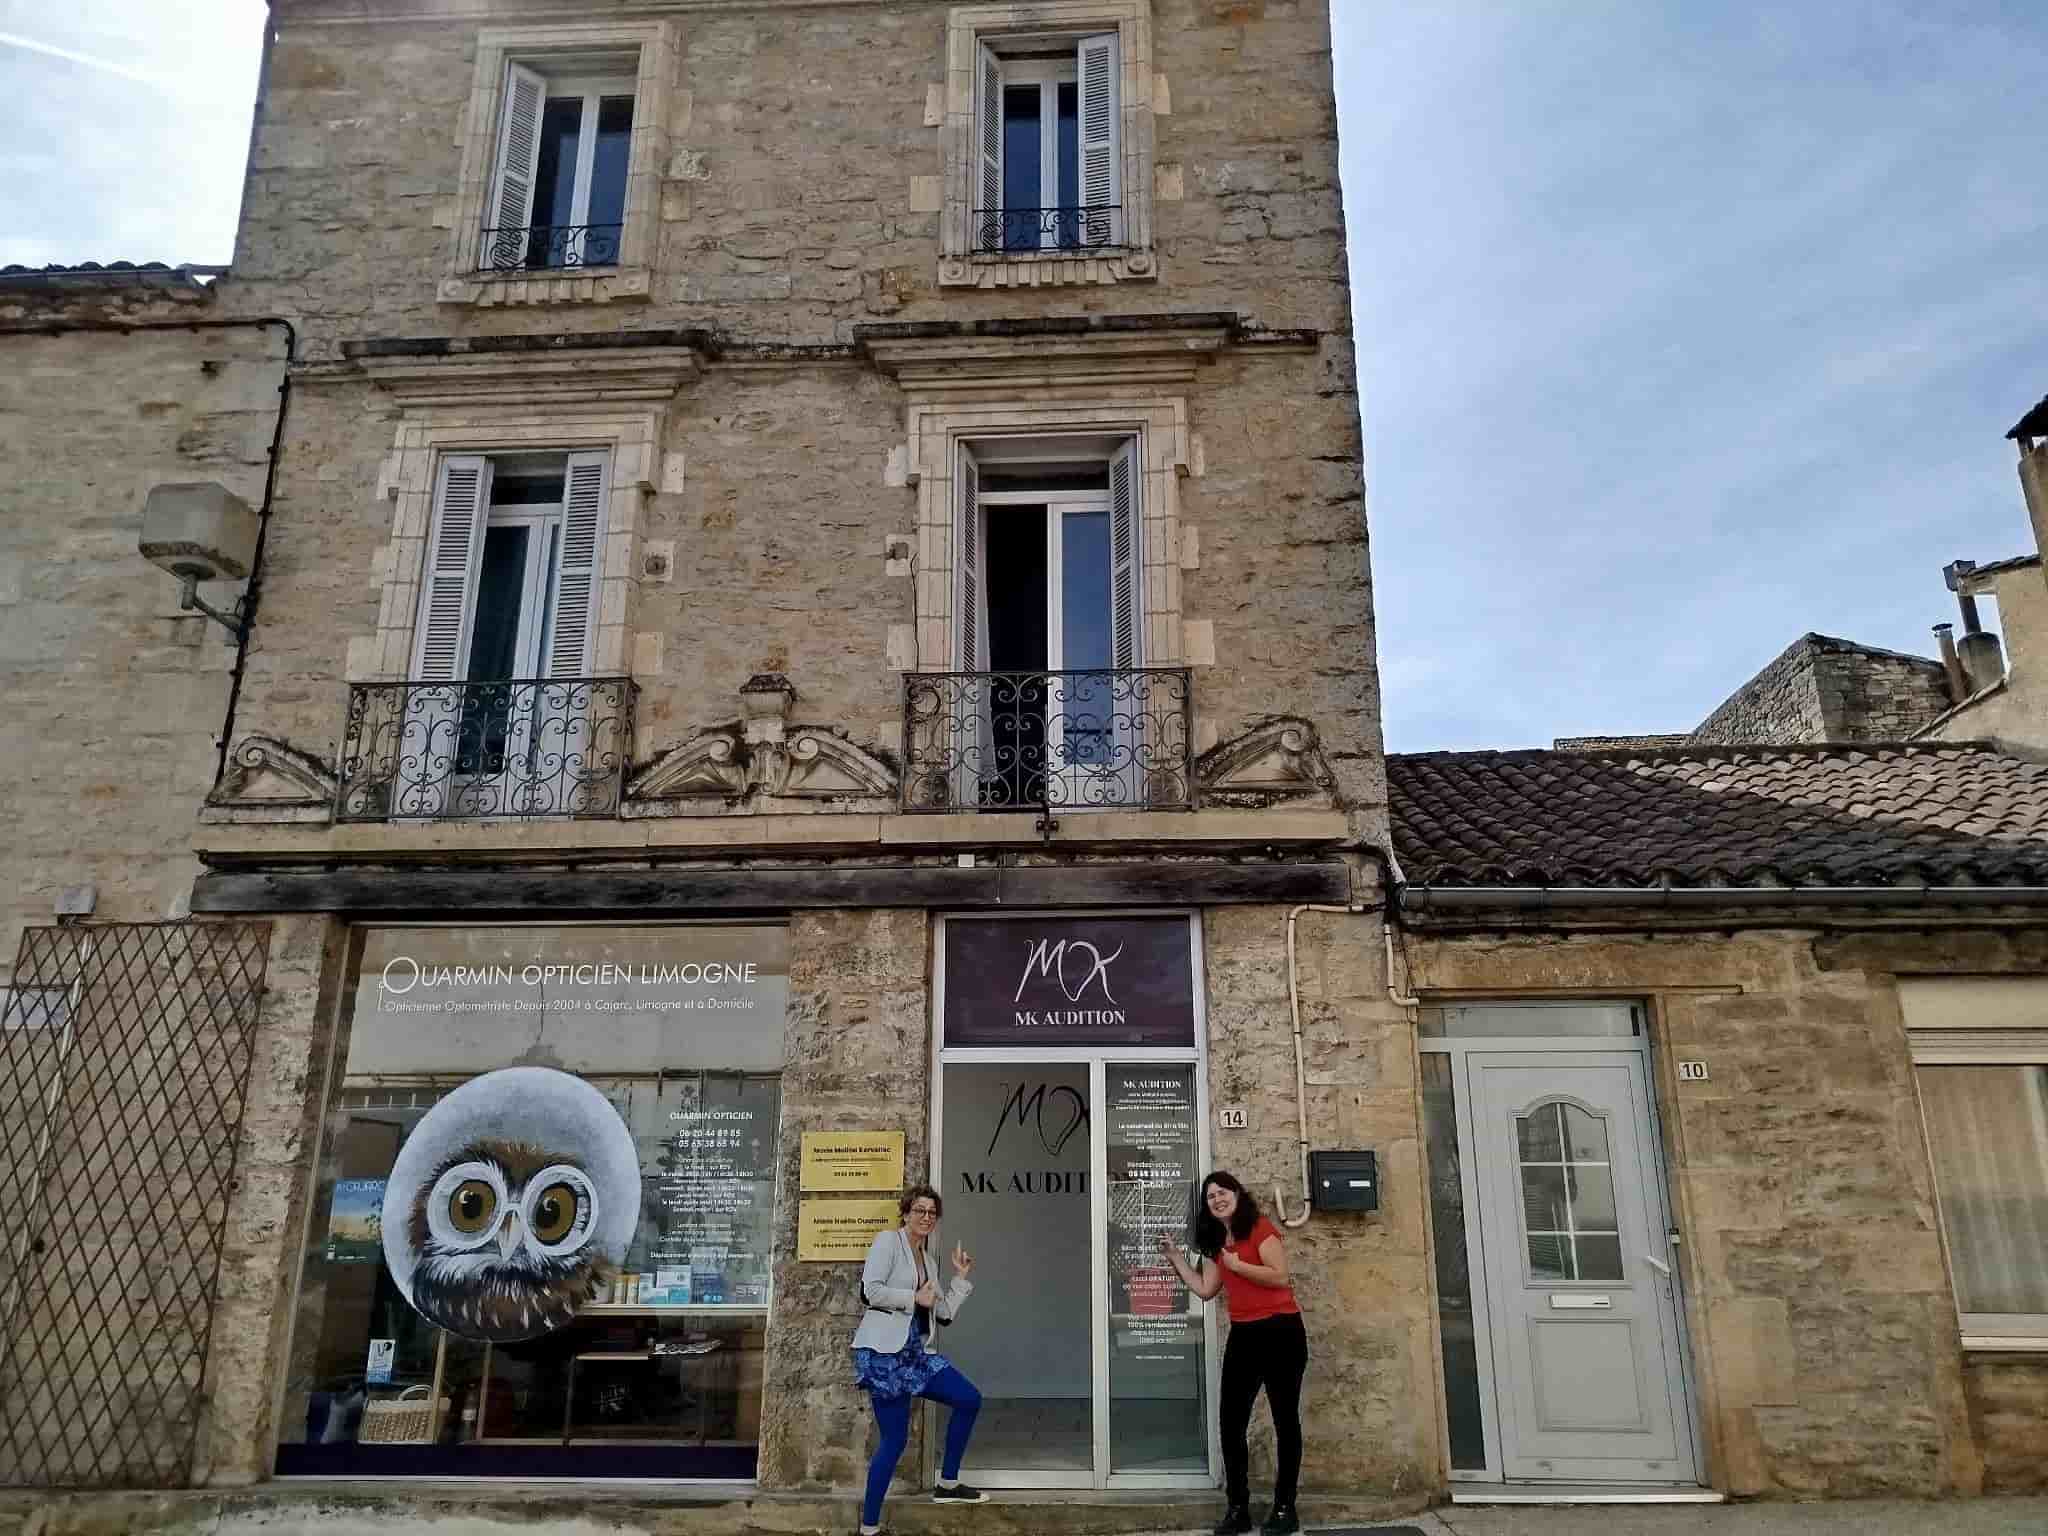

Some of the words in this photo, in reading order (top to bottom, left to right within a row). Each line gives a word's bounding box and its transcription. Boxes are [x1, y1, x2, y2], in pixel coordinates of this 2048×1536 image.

[521, 963, 632, 985] OPTICIEN
[641, 962, 757, 985] LIMOGNE
[515, 999, 548, 1013] Depuis
[637, 999, 680, 1012] Limogne
[708, 997, 755, 1009] Domicile
[1015, 1010, 1038, 1025] MK
[1042, 1009, 1125, 1025] AUDITION
[1682, 1063, 1703, 1077] 10
[1138, 1080, 1181, 1088] AUDITION
[713, 1111, 753, 1120] OPTICIEN
[1224, 1111, 1243, 1126] 14
[704, 1129, 715, 1137] 44
[961, 1172, 999, 1194] MK
